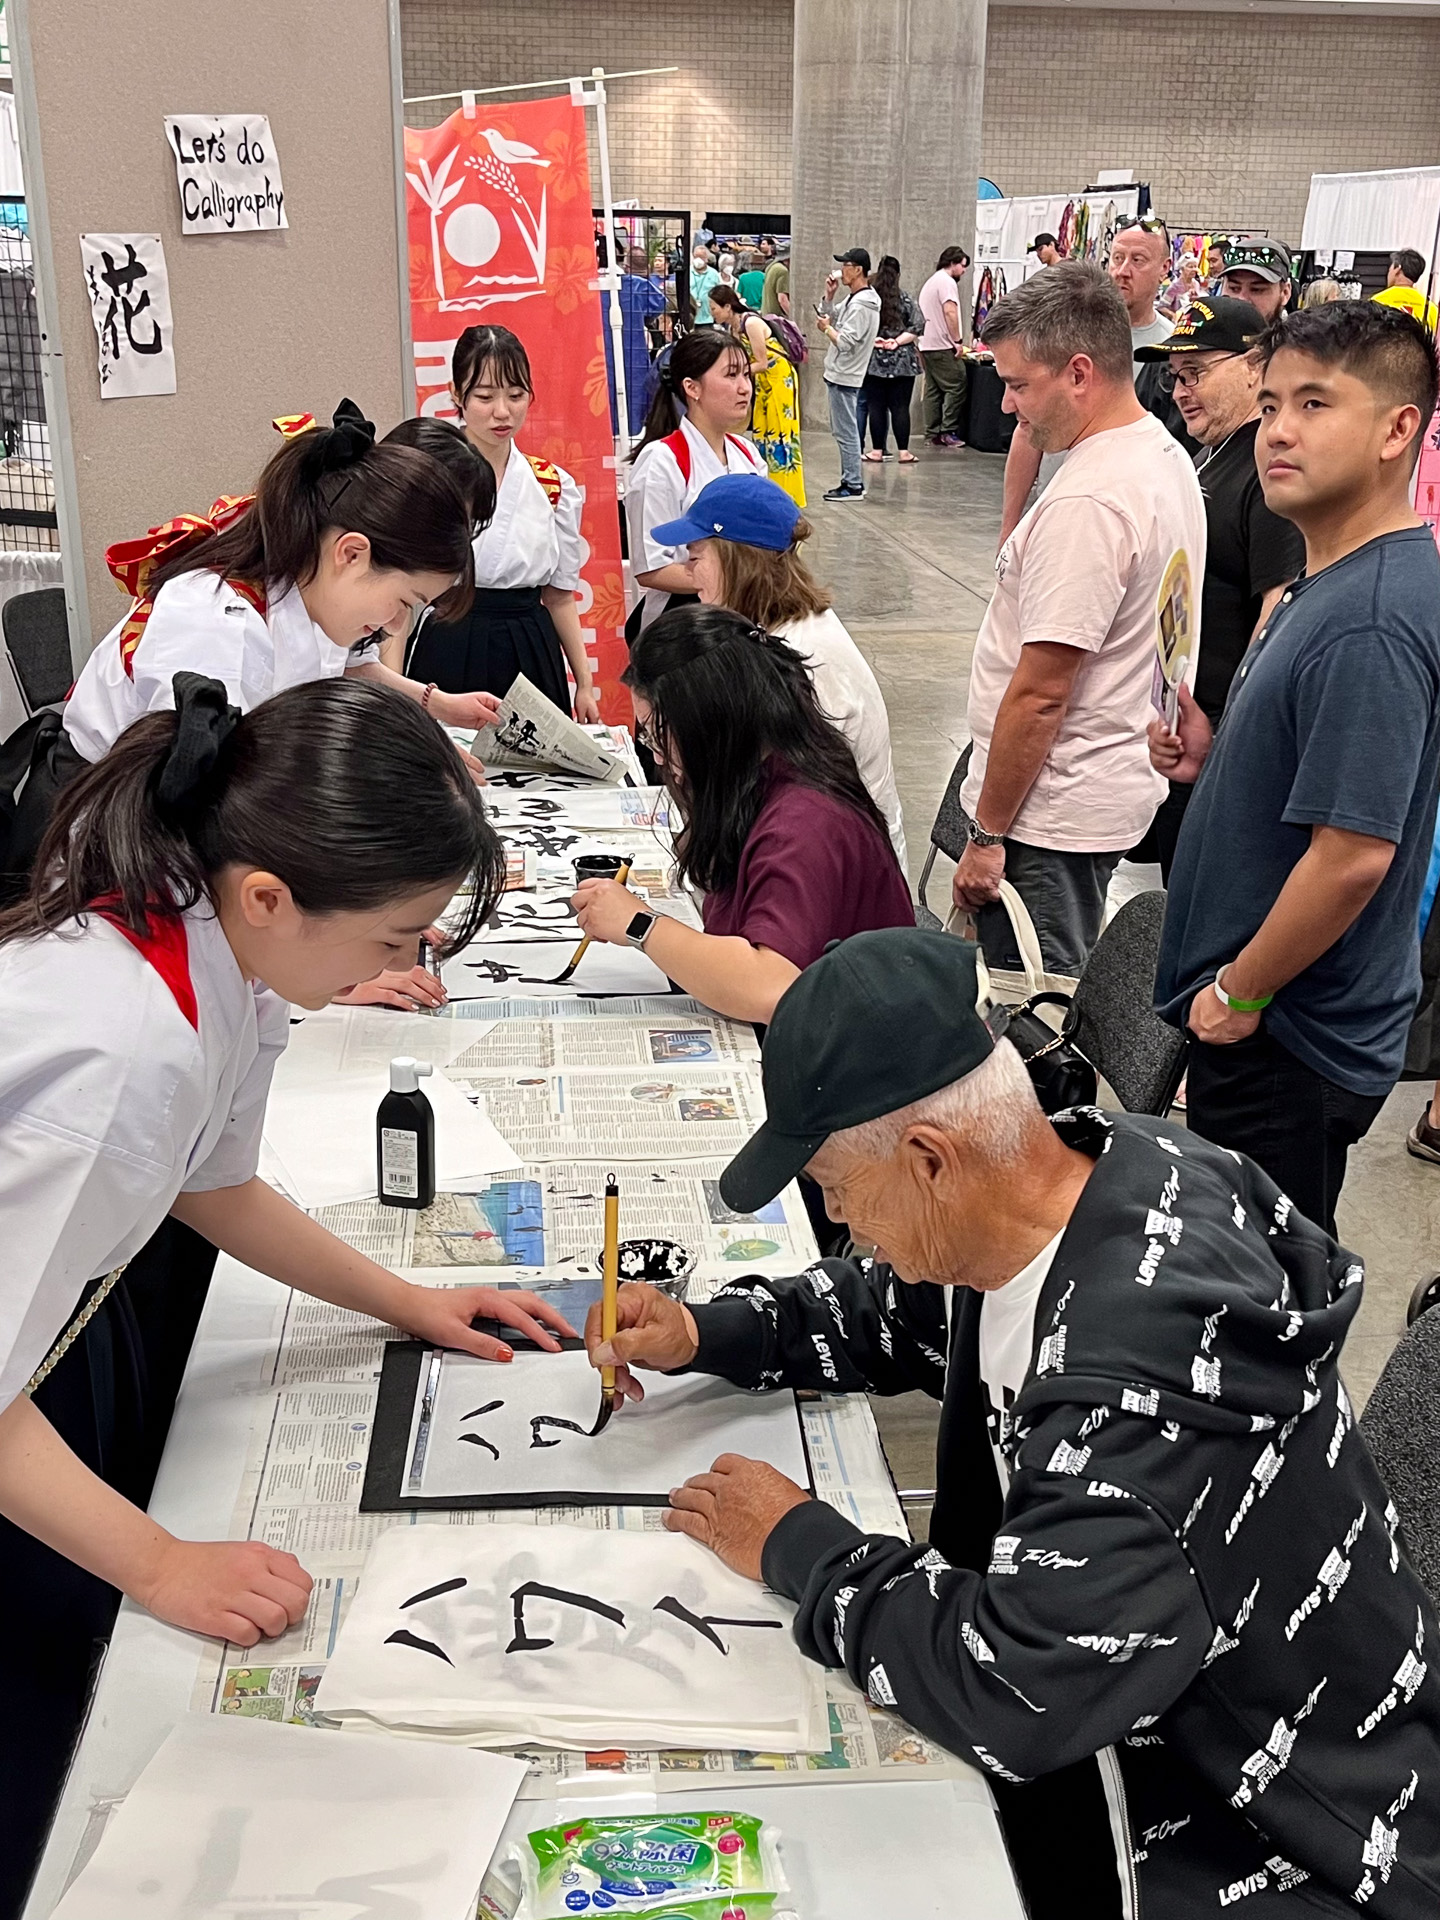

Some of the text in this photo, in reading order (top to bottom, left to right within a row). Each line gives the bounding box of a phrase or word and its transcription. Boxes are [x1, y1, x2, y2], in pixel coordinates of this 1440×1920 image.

[173, 125, 265, 165] Let's do
[182, 175, 284, 229] Calligraphy
[101, 243, 163, 360] 花
